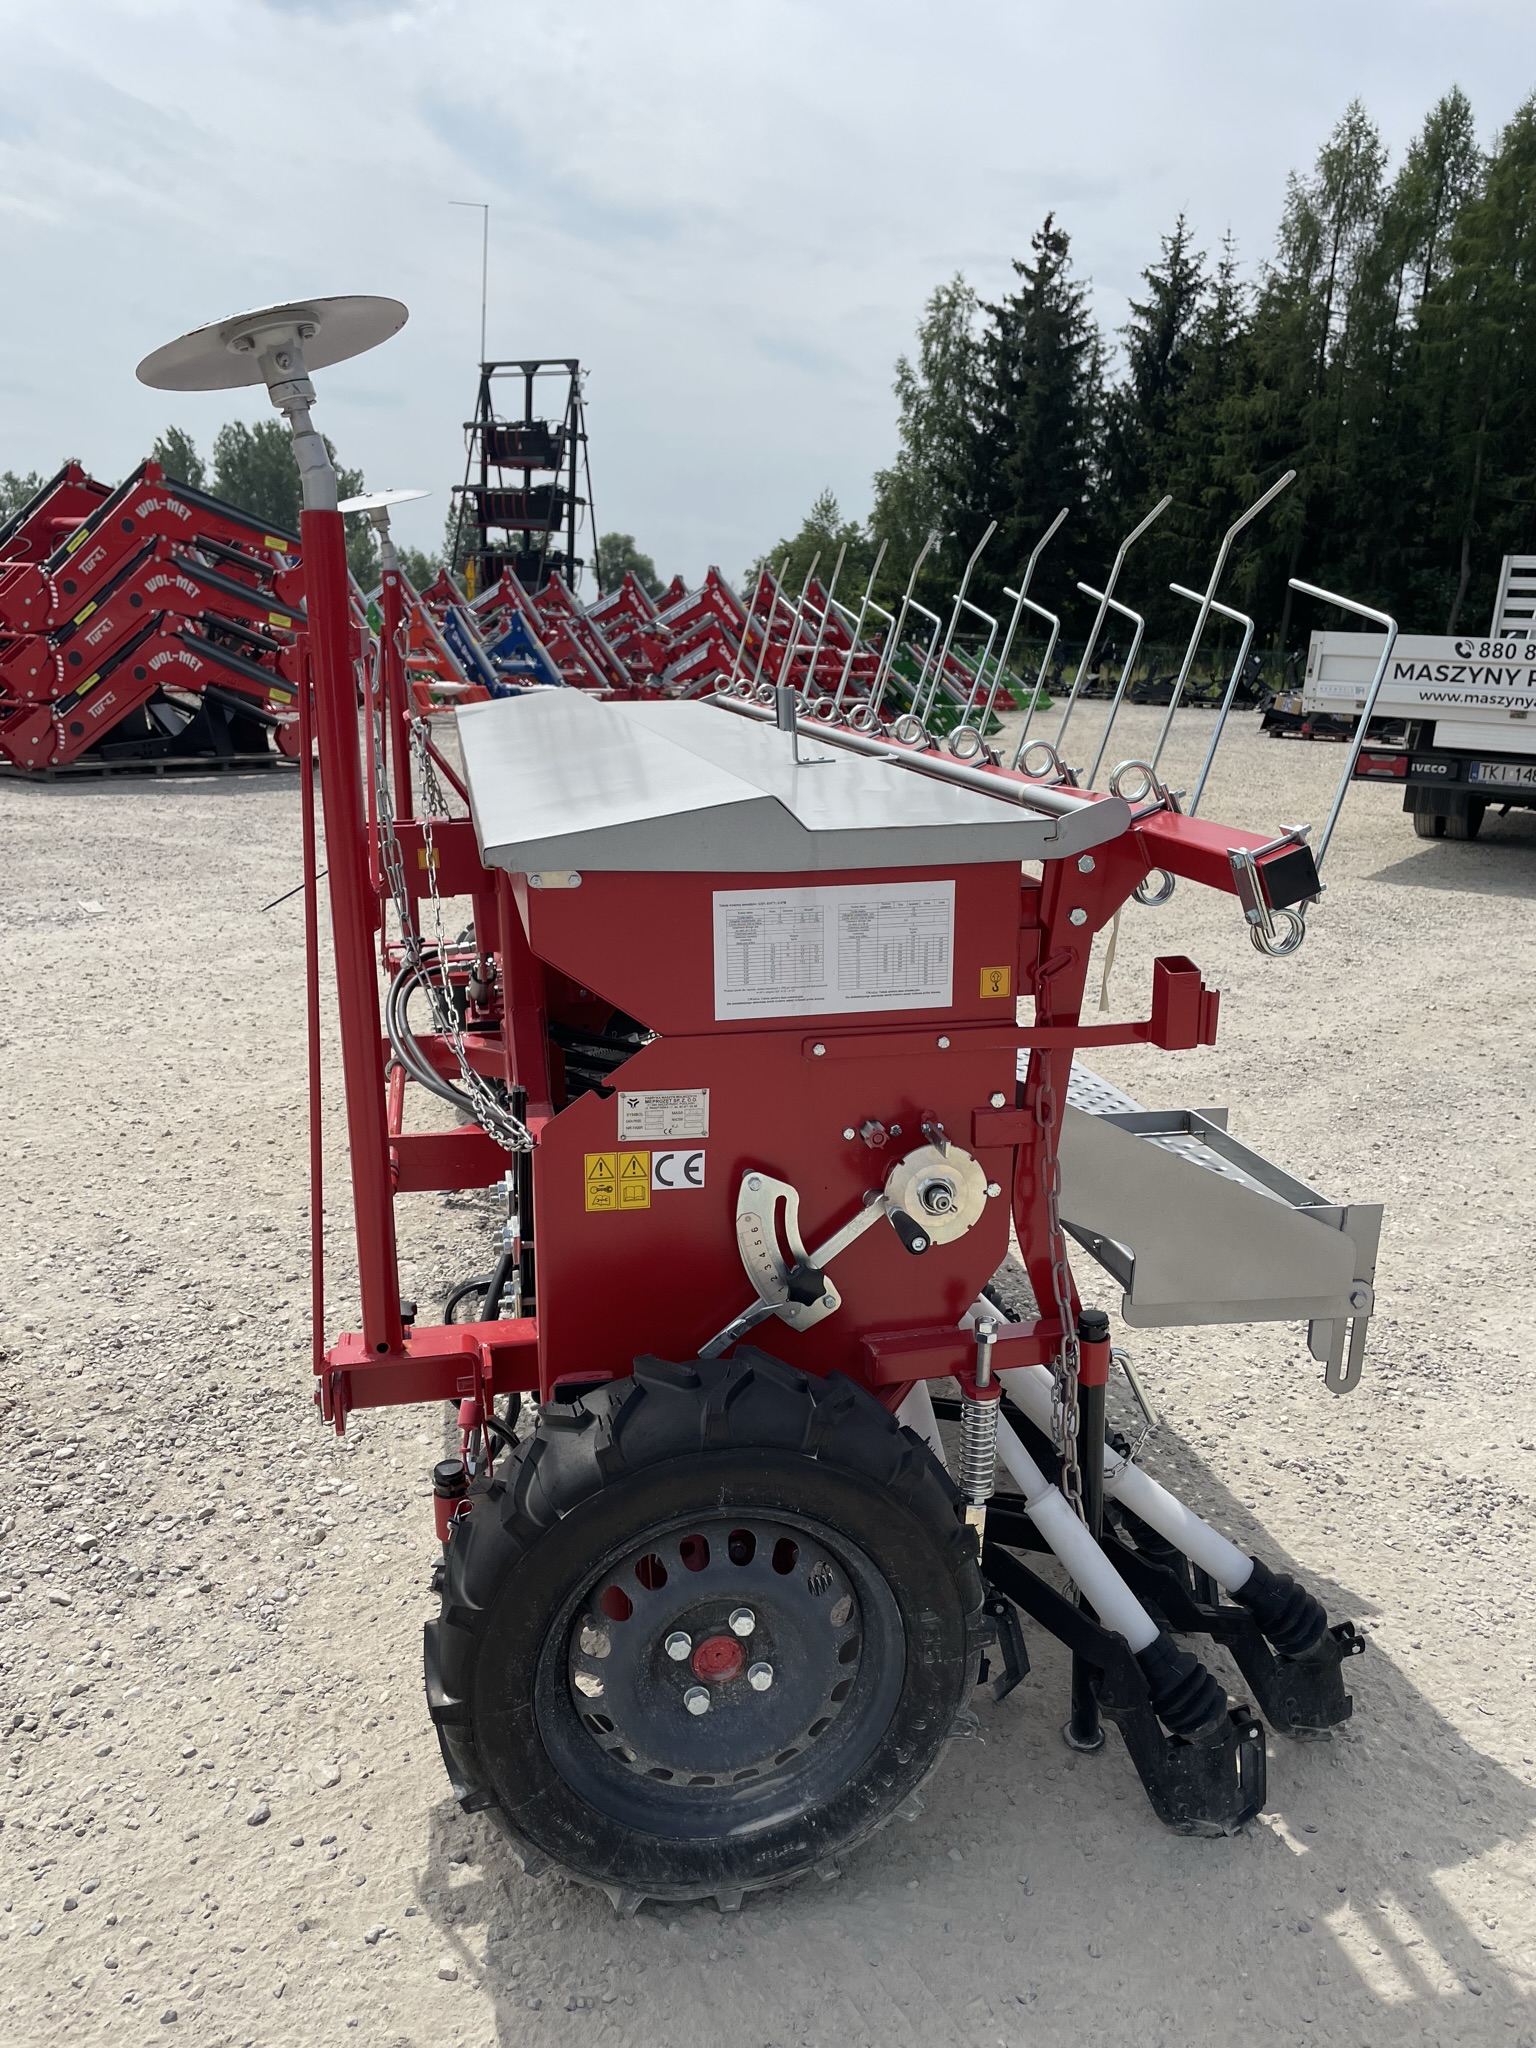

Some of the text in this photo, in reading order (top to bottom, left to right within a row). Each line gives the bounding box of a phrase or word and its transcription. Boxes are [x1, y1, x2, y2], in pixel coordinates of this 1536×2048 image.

[135, 498, 193, 521] WOL-MET
[144, 574, 201, 598] WOL-MET
[148, 650, 203, 672] WOL-MET
[1478, 642, 1517, 659] 880
[1393, 662, 1522, 686] MASZYNY
[1419, 691, 1536, 709] www.maszyny
[1411, 763, 1447, 774] IVECO
[655, 1152, 703, 1187] CE
[764, 1263, 772, 1271] 3
